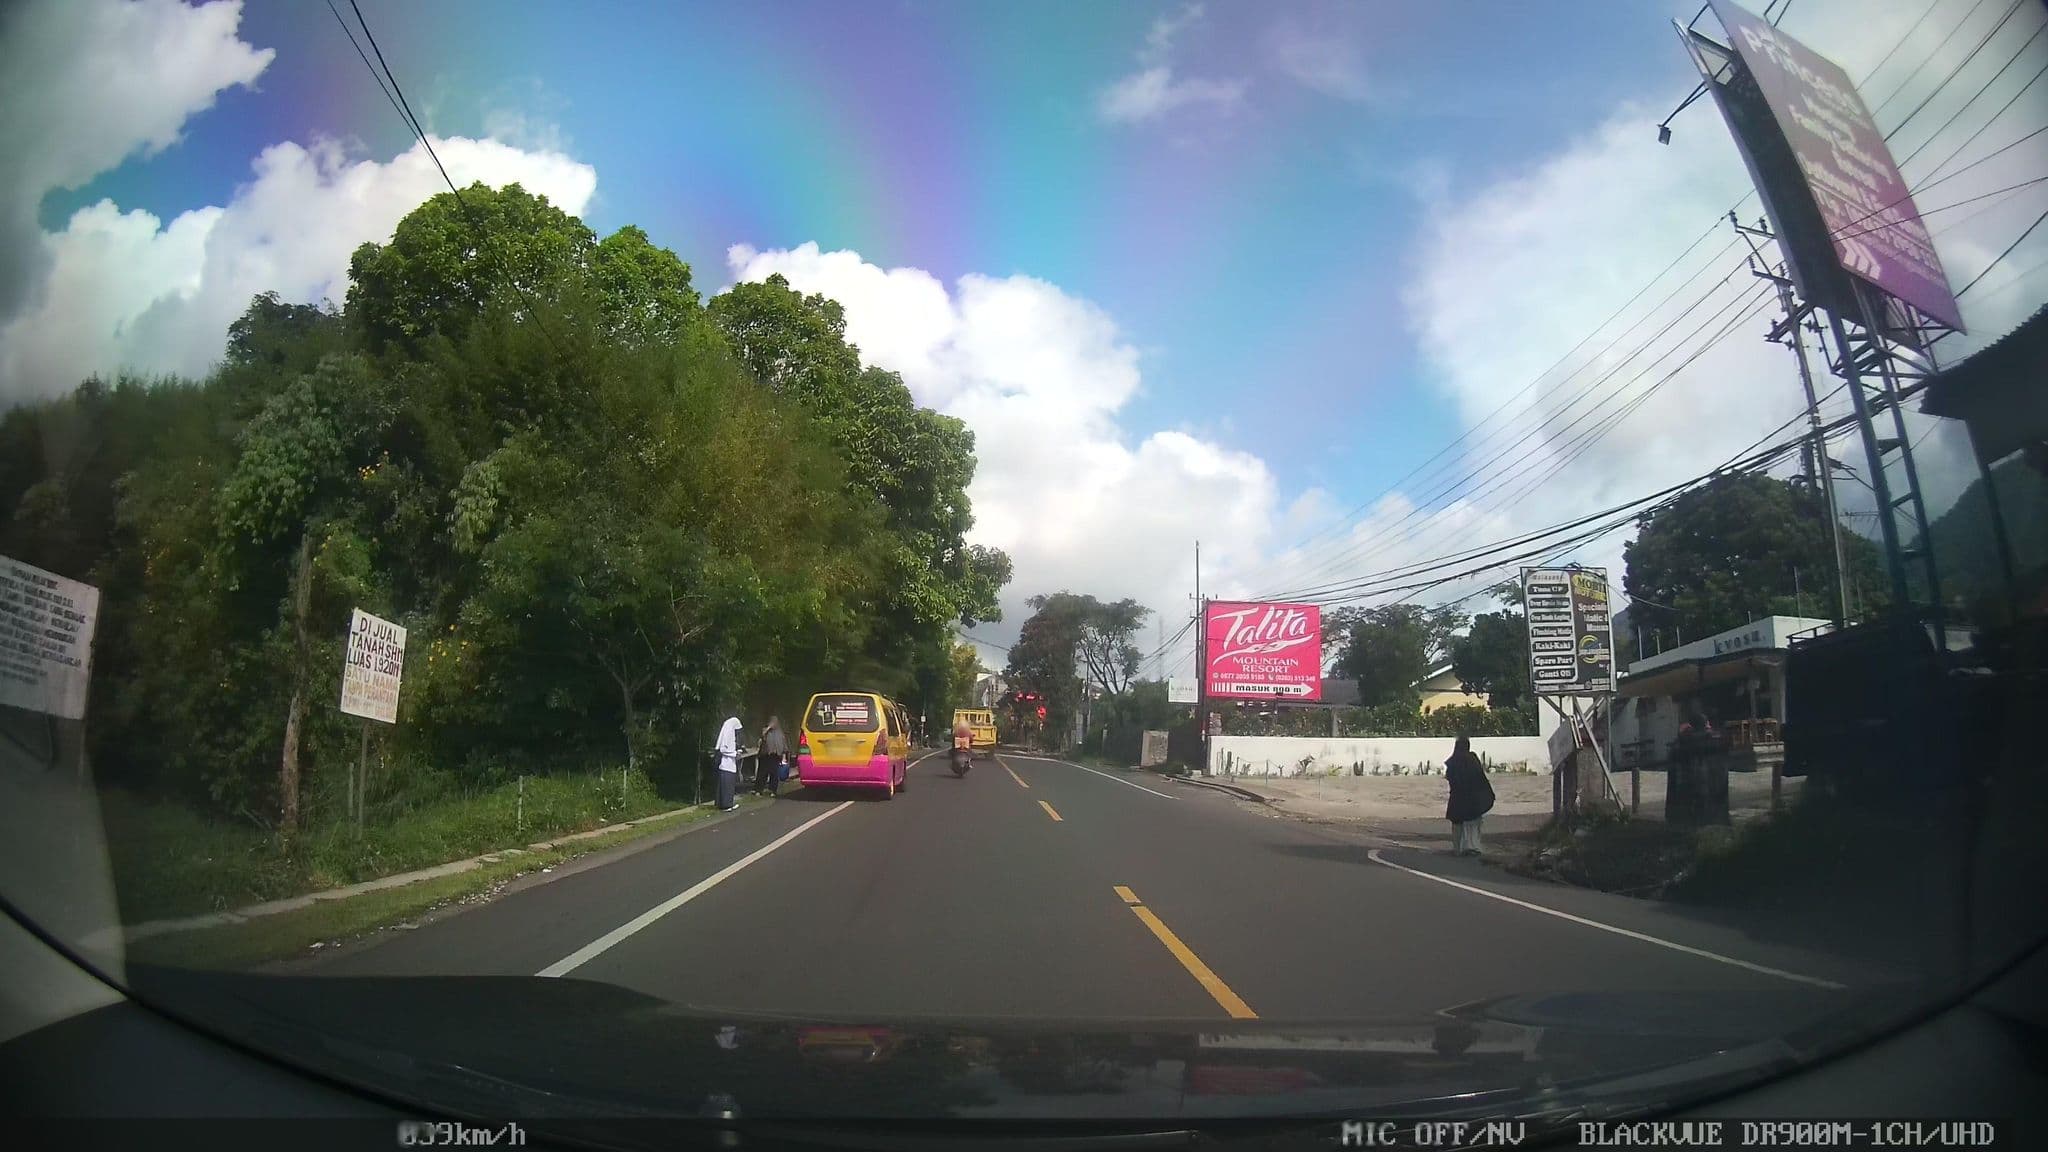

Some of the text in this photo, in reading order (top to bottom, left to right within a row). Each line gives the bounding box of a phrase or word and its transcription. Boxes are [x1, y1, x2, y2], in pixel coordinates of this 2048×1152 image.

[360, 617, 398, 645] DI JUAL
[1211, 606, 1308, 651] Talita
[352, 631, 384, 656] TANAH
[347, 648, 372, 669] LUAS
[1232, 656, 1299, 667] MOUNTAIN
[1242, 664, 1290, 673] RESORT
